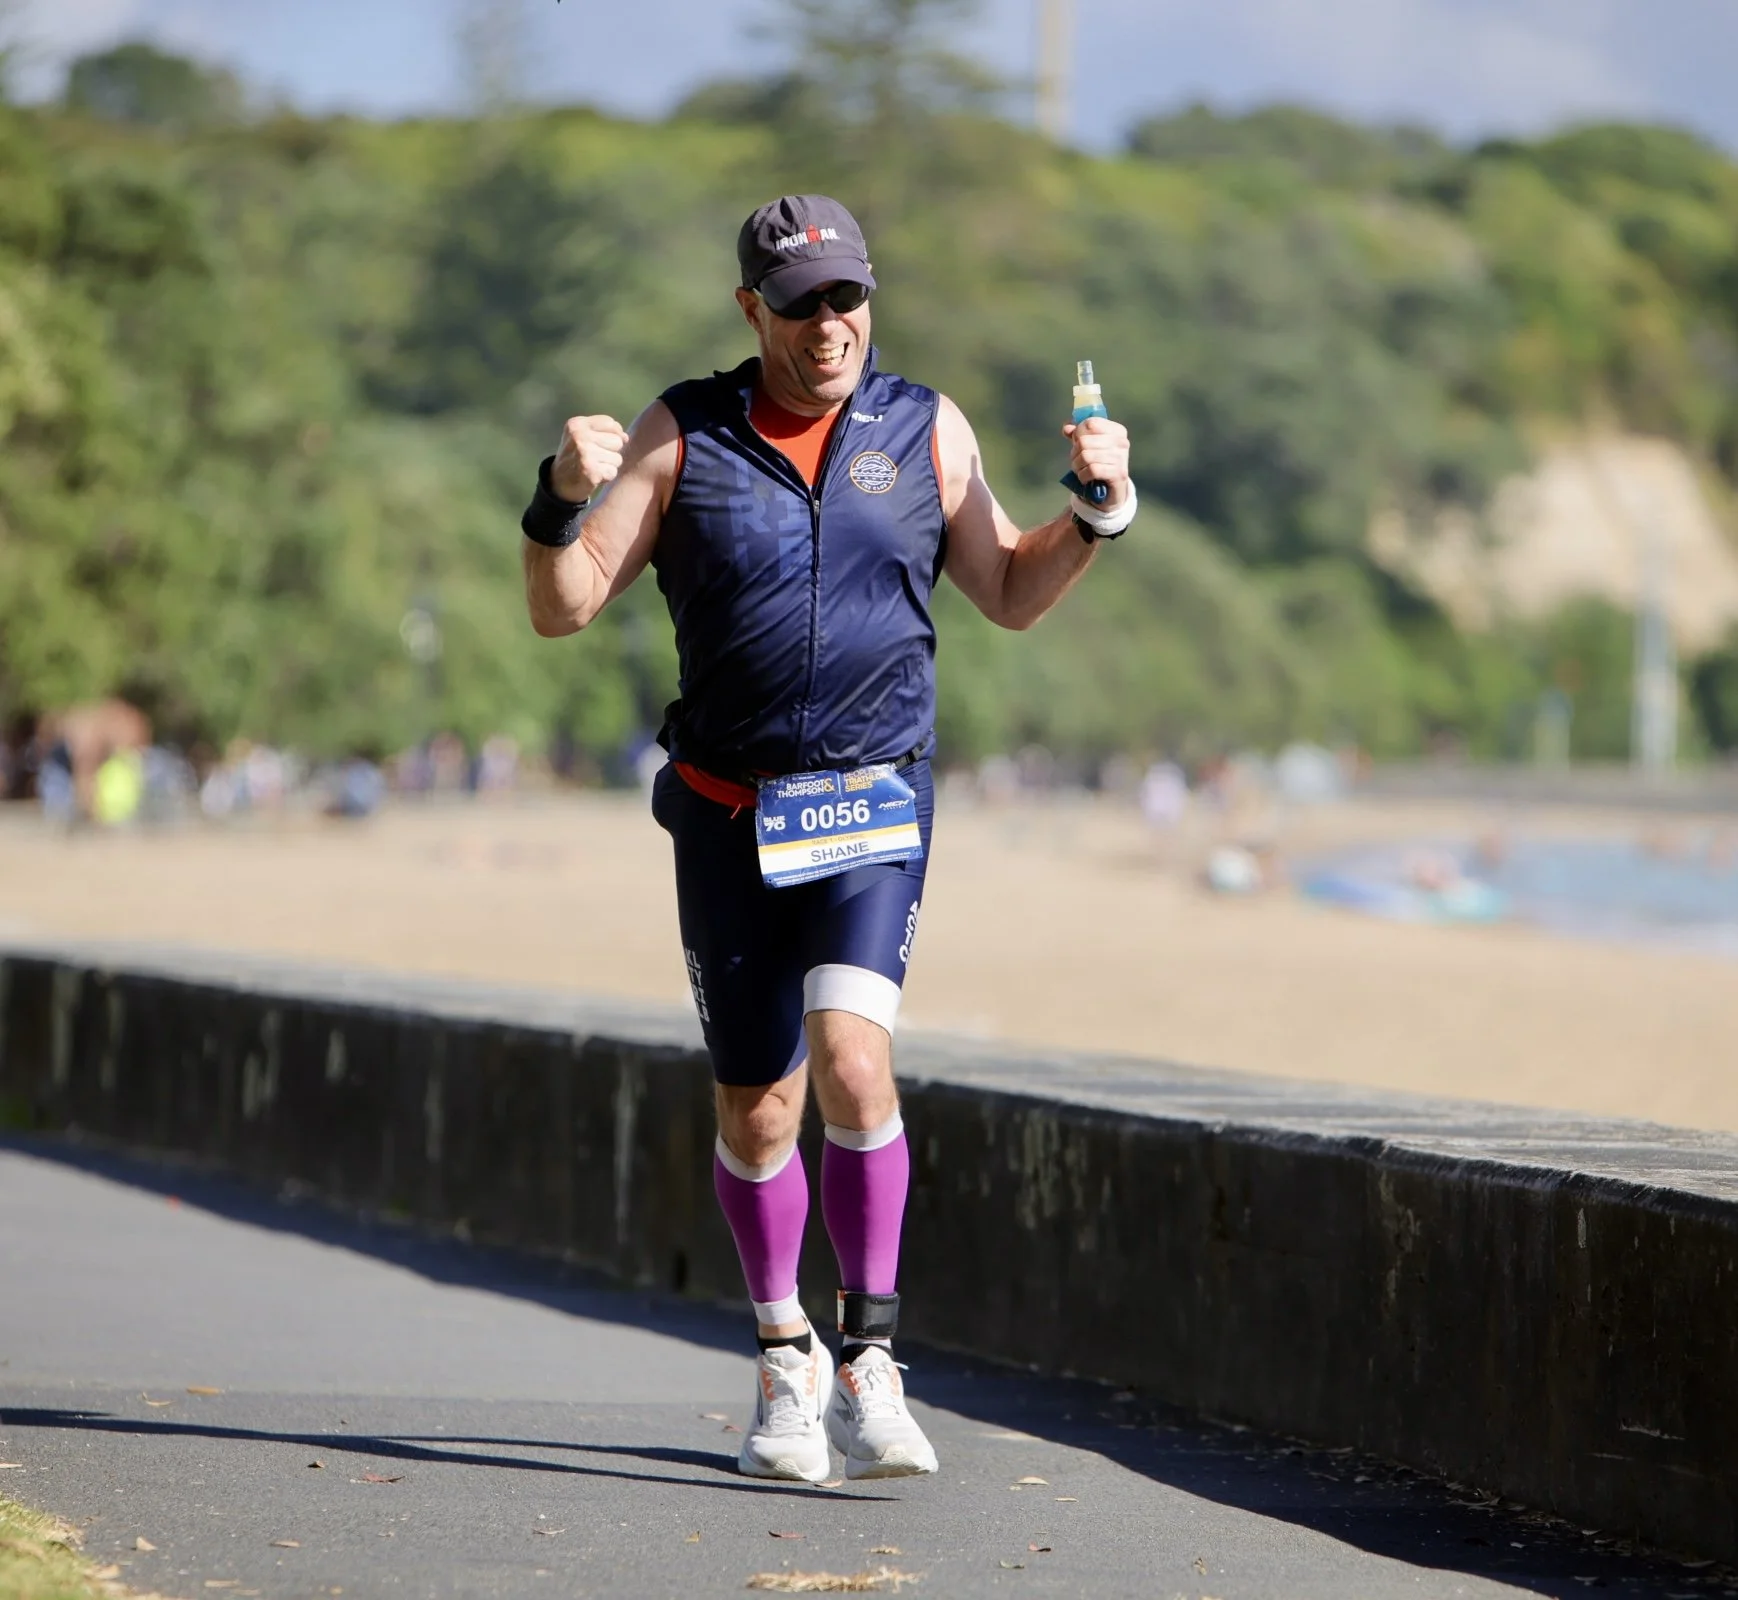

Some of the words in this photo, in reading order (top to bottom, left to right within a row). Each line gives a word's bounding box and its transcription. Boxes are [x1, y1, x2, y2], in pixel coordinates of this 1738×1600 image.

[775, 224, 840, 250] IRONMAN
[786, 779, 824, 791] BARFOOT
[823, 777, 836, 793] &
[845, 781, 873, 792] SERIES
[776, 786, 825, 799] THOMPSON
[763, 815, 786, 823] BLUE
[800, 798, 871, 832] 0056
[763, 821, 786, 832] 70
[811, 841, 870, 863] SHANE
